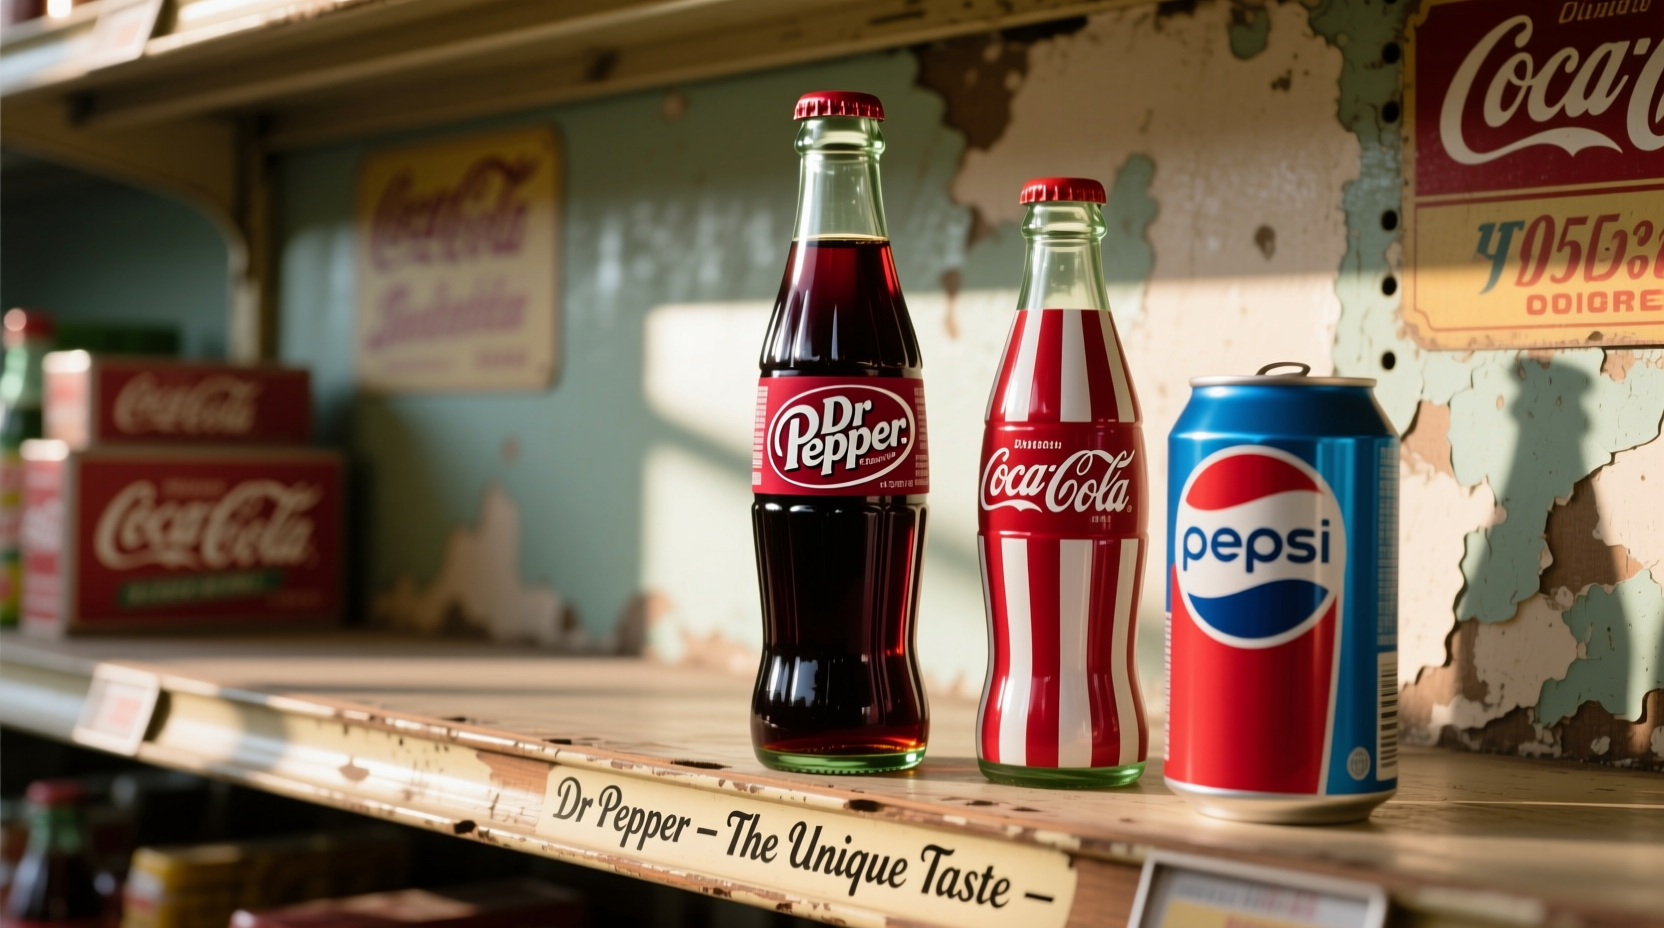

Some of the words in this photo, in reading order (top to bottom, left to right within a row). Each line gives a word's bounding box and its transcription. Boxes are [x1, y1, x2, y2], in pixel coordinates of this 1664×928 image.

[821, 395, 872, 435] Dr
[980, 447, 1135, 513] Coca-Cola
[1183, 519, 1330, 573] pepsi
[552, 776, 594, 822] Dr
[596, 784, 691, 851] Pepper
[726, 810, 779, 863] The
[788, 821, 908, 897] Unique
[921, 844, 1010, 909] Taste
